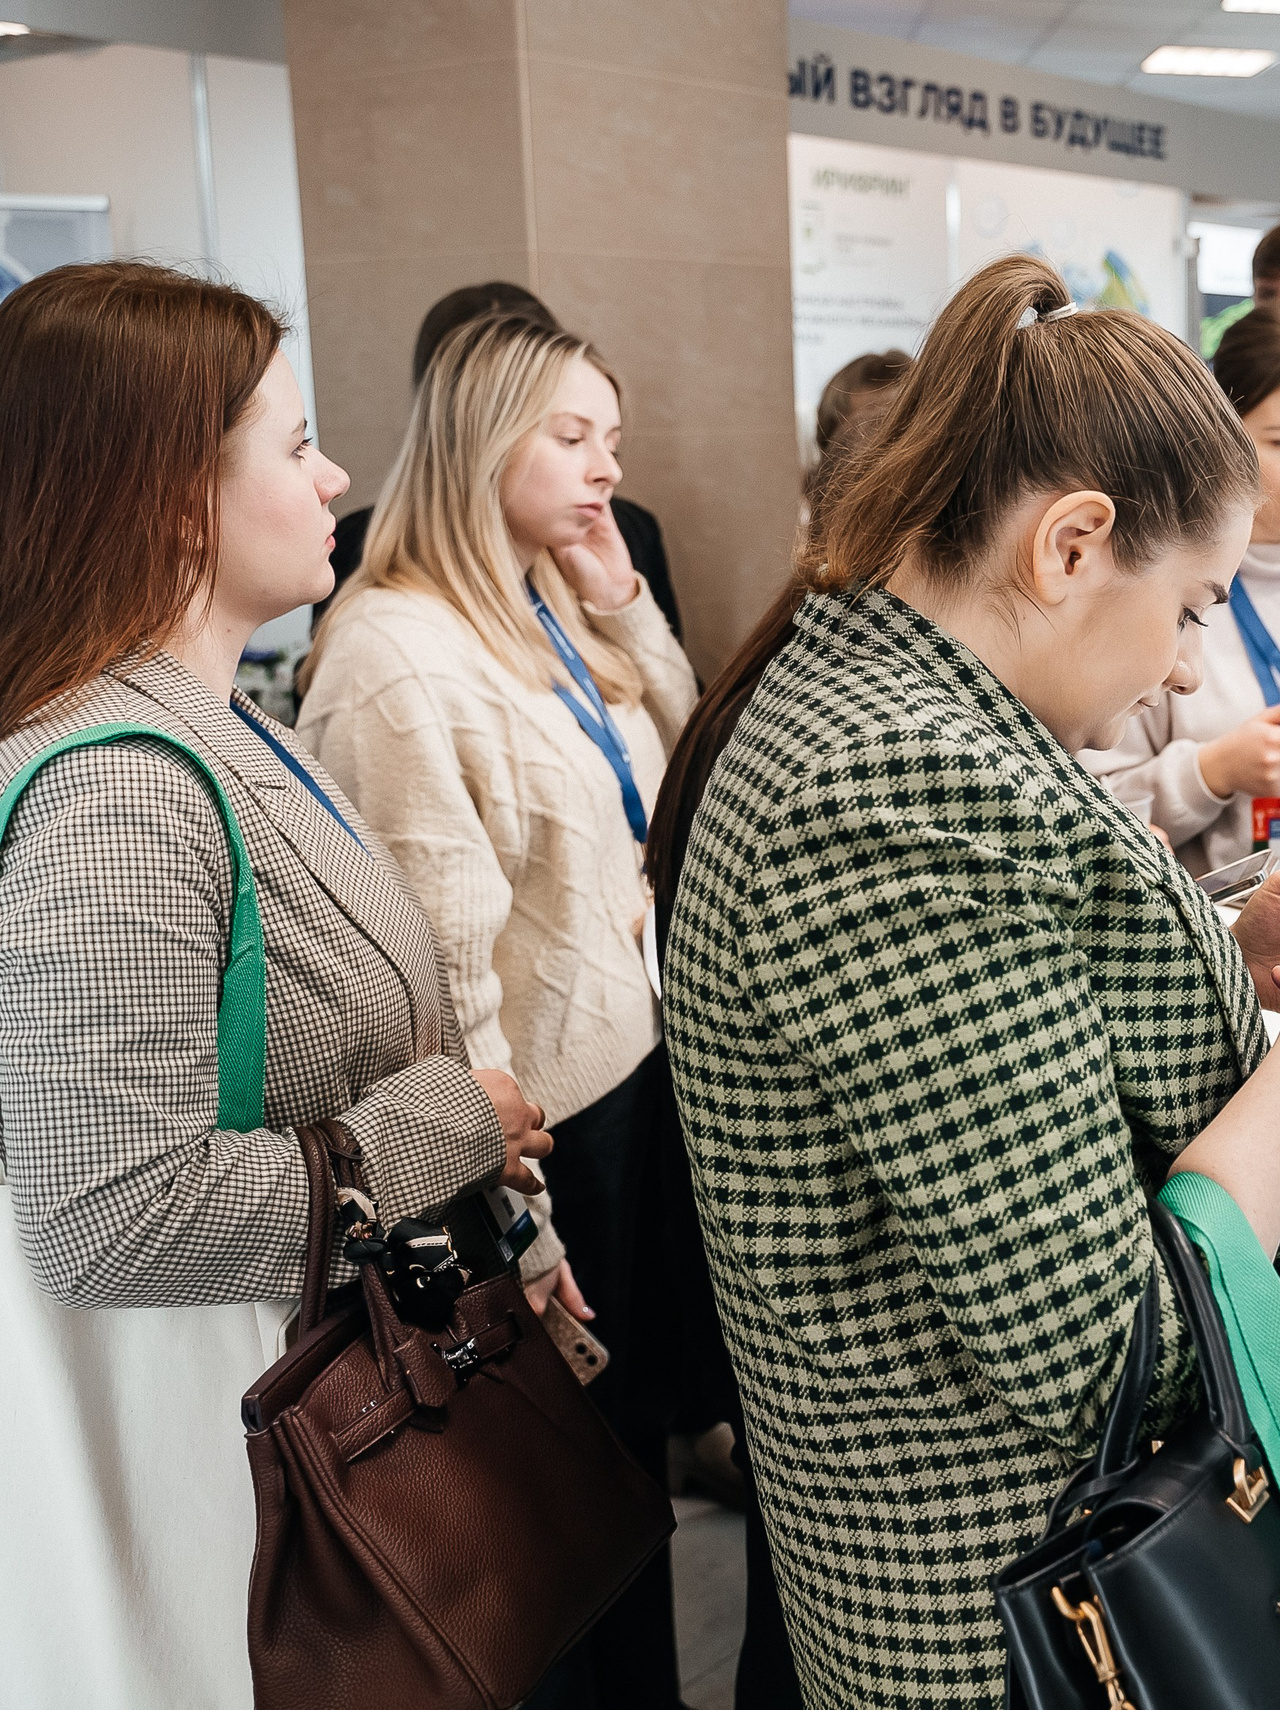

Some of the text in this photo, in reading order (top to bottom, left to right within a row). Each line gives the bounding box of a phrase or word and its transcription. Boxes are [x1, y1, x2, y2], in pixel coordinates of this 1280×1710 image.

[850, 68, 989, 134] ВЗГЛЯД
[1002, 96, 1019, 133] В
[1031, 103, 1165, 159] БУДУЩЕЕ
